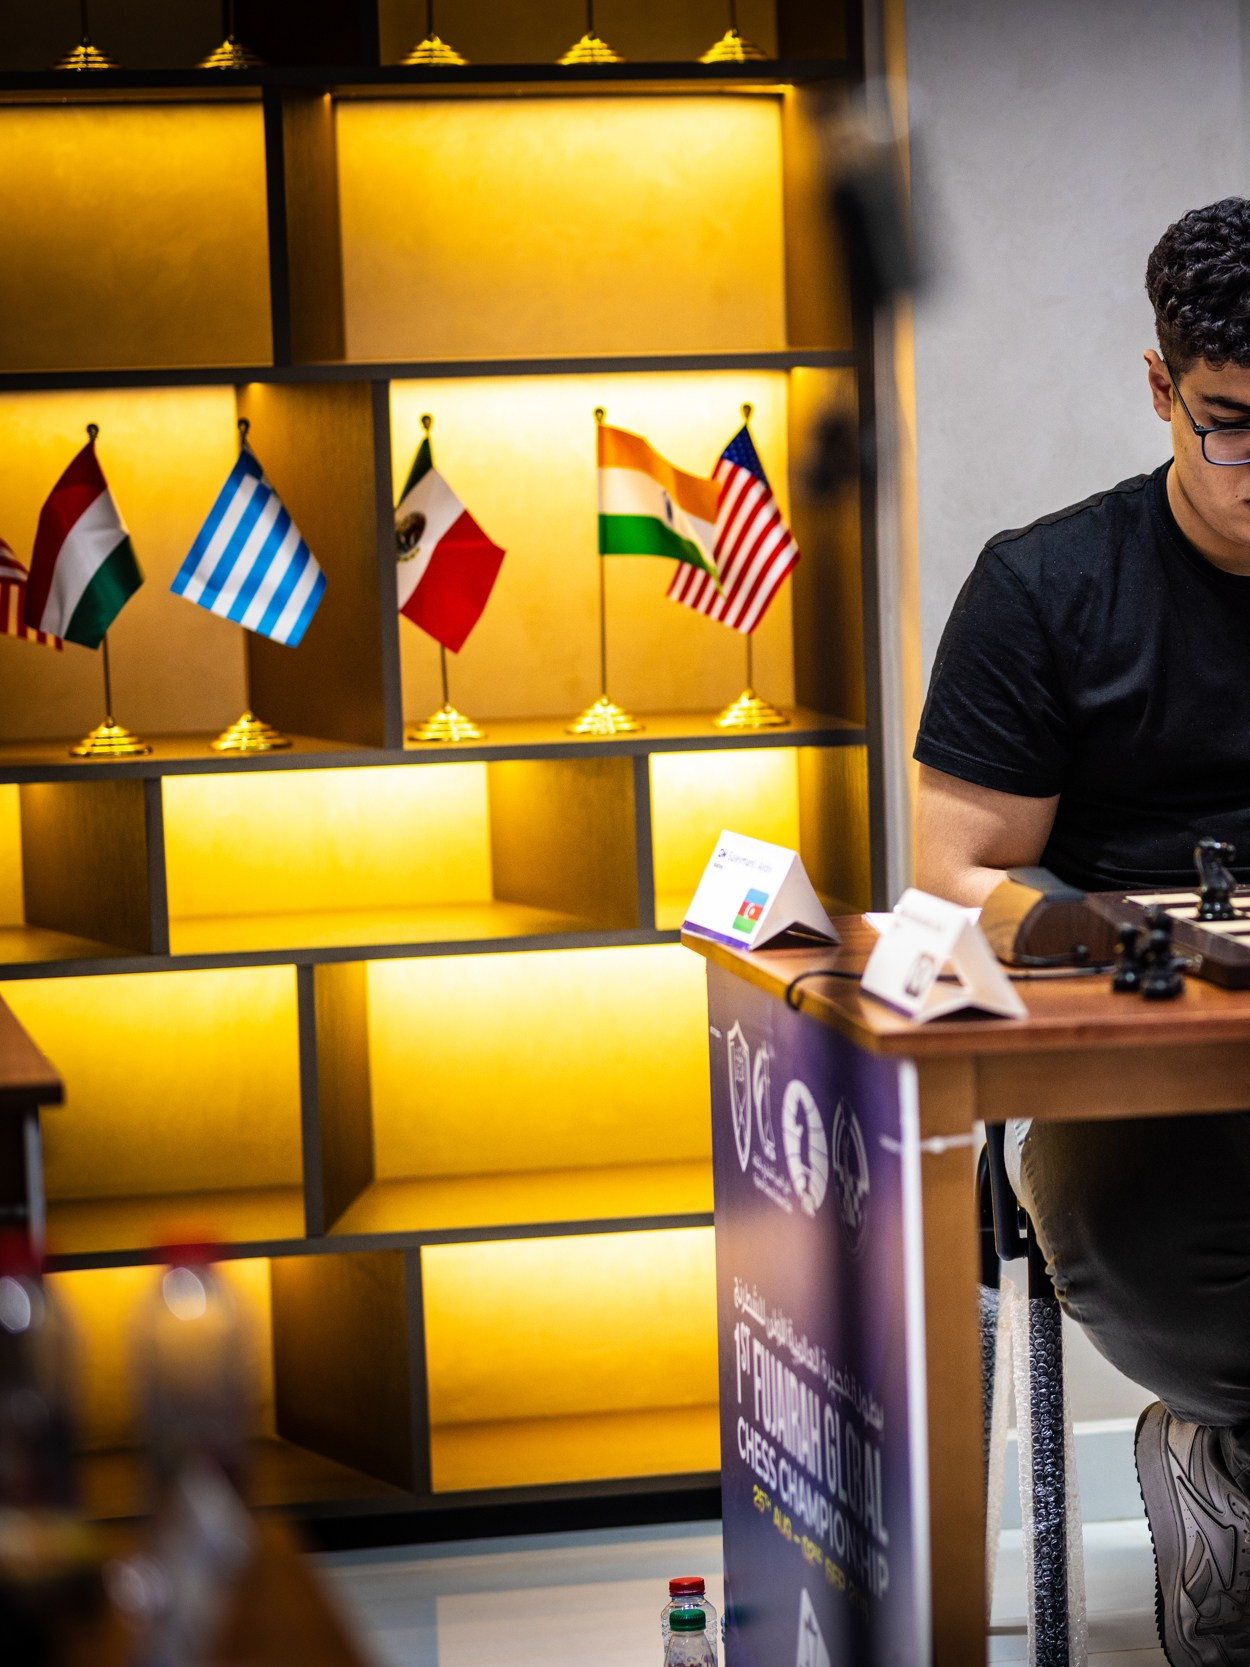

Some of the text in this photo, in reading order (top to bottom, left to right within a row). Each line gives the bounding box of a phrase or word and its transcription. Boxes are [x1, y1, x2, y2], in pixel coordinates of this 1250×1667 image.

[752, 1337, 823, 1483] FUJAIRAH
[737, 1416, 890, 1599] CHESS CHAMPIONHIP
